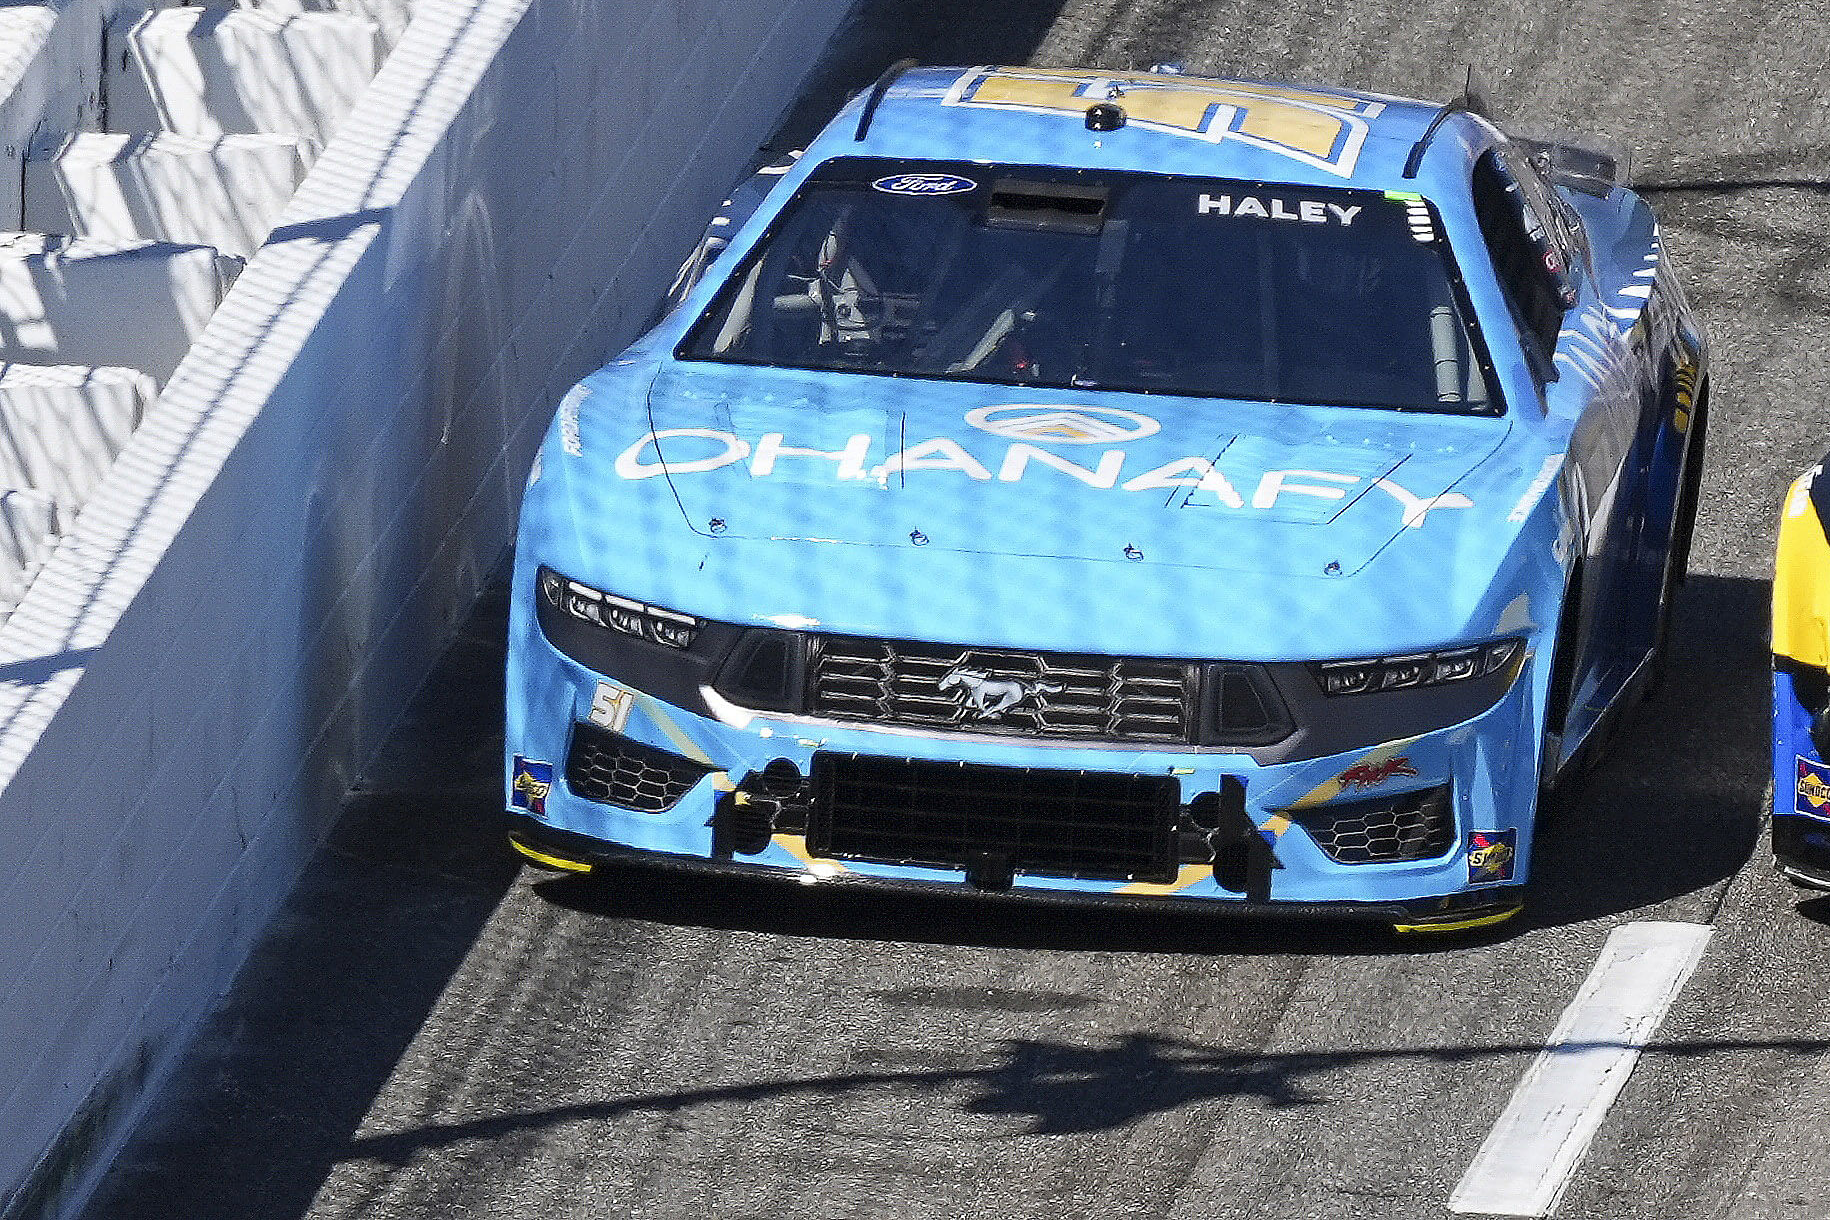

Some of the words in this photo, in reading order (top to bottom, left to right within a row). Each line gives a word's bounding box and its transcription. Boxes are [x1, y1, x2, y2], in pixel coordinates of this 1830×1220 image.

[1199, 194, 1362, 226] HALEY
[613, 426, 1475, 530] OHANAFY
[589, 680, 635, 732] 51
